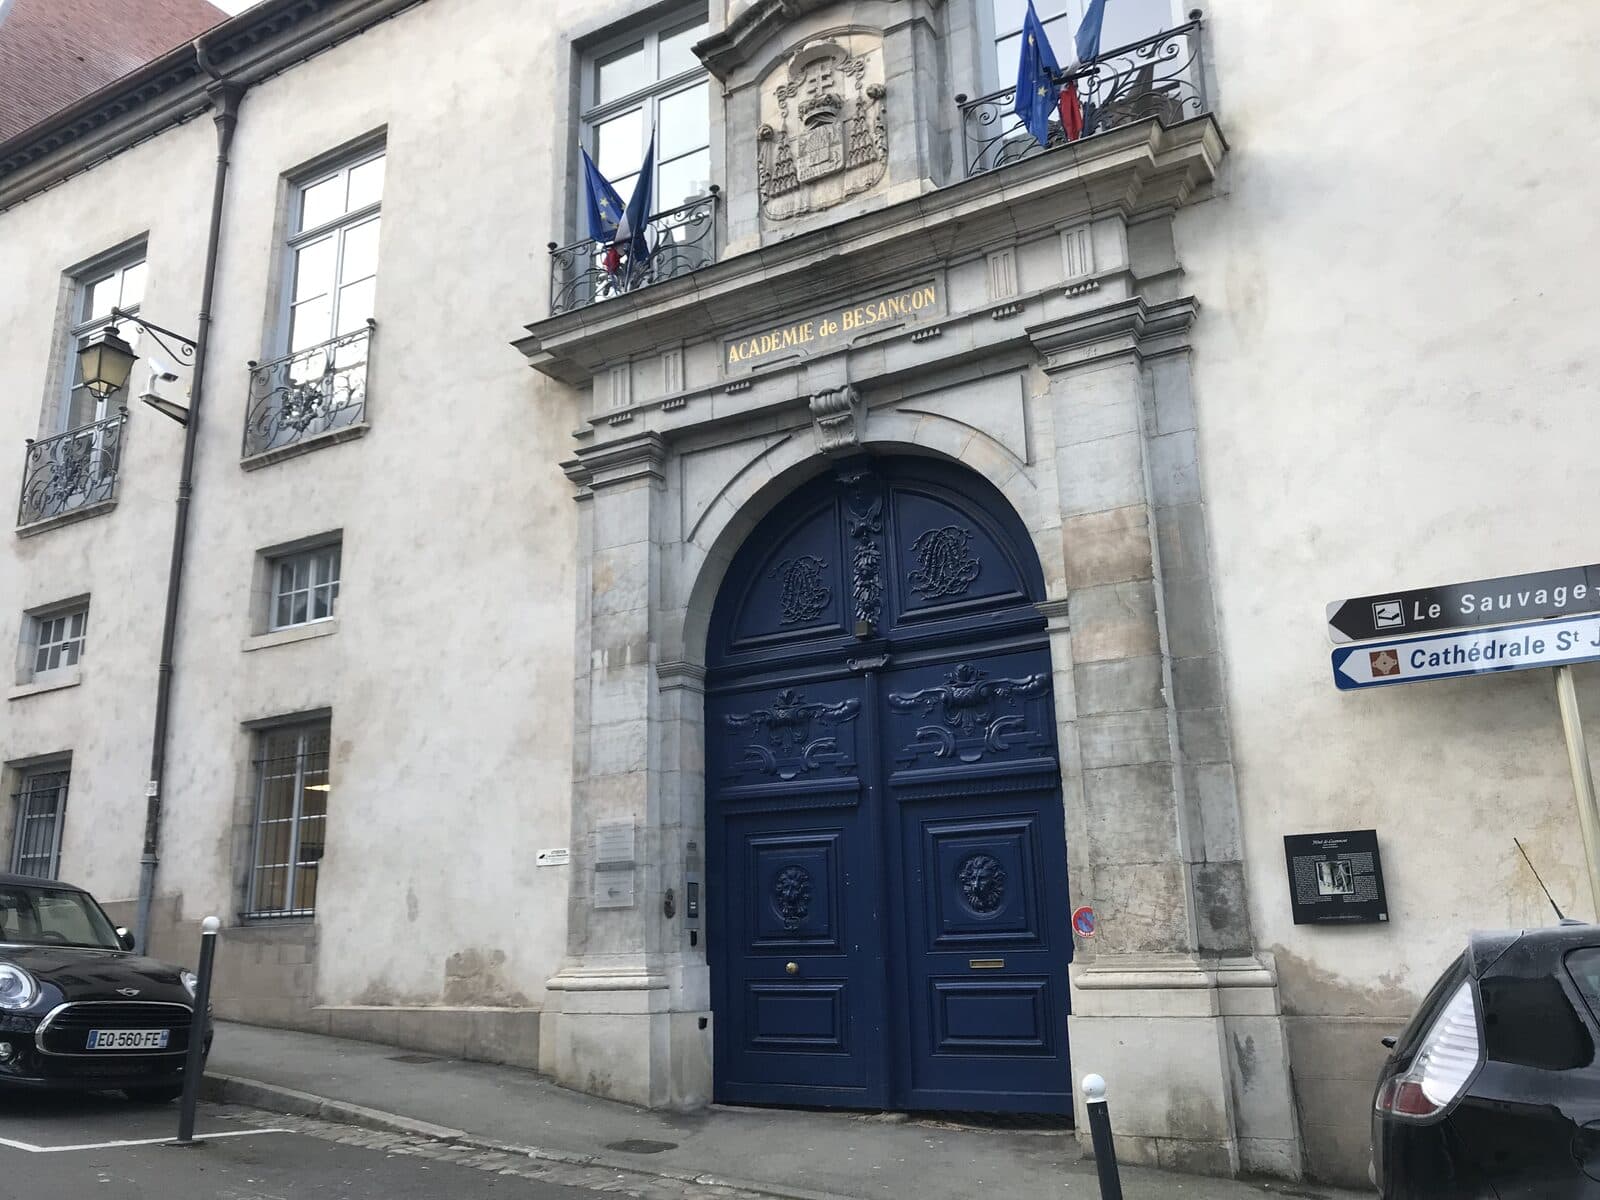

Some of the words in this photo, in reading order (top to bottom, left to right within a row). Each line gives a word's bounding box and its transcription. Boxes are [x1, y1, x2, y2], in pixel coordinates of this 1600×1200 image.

[728, 321, 815, 363] ACADÉMIE
[819, 319, 838, 337] de
[842, 286, 936, 331] BESANÇON
[1413, 601, 1441, 621] Le
[1459, 583, 1587, 615] Sauvage
[1410, 635, 1546, 669] Cathédrale
[1556, 630, 1580, 651] St
[97, 1032, 161, 1047] EQ-560-FE
